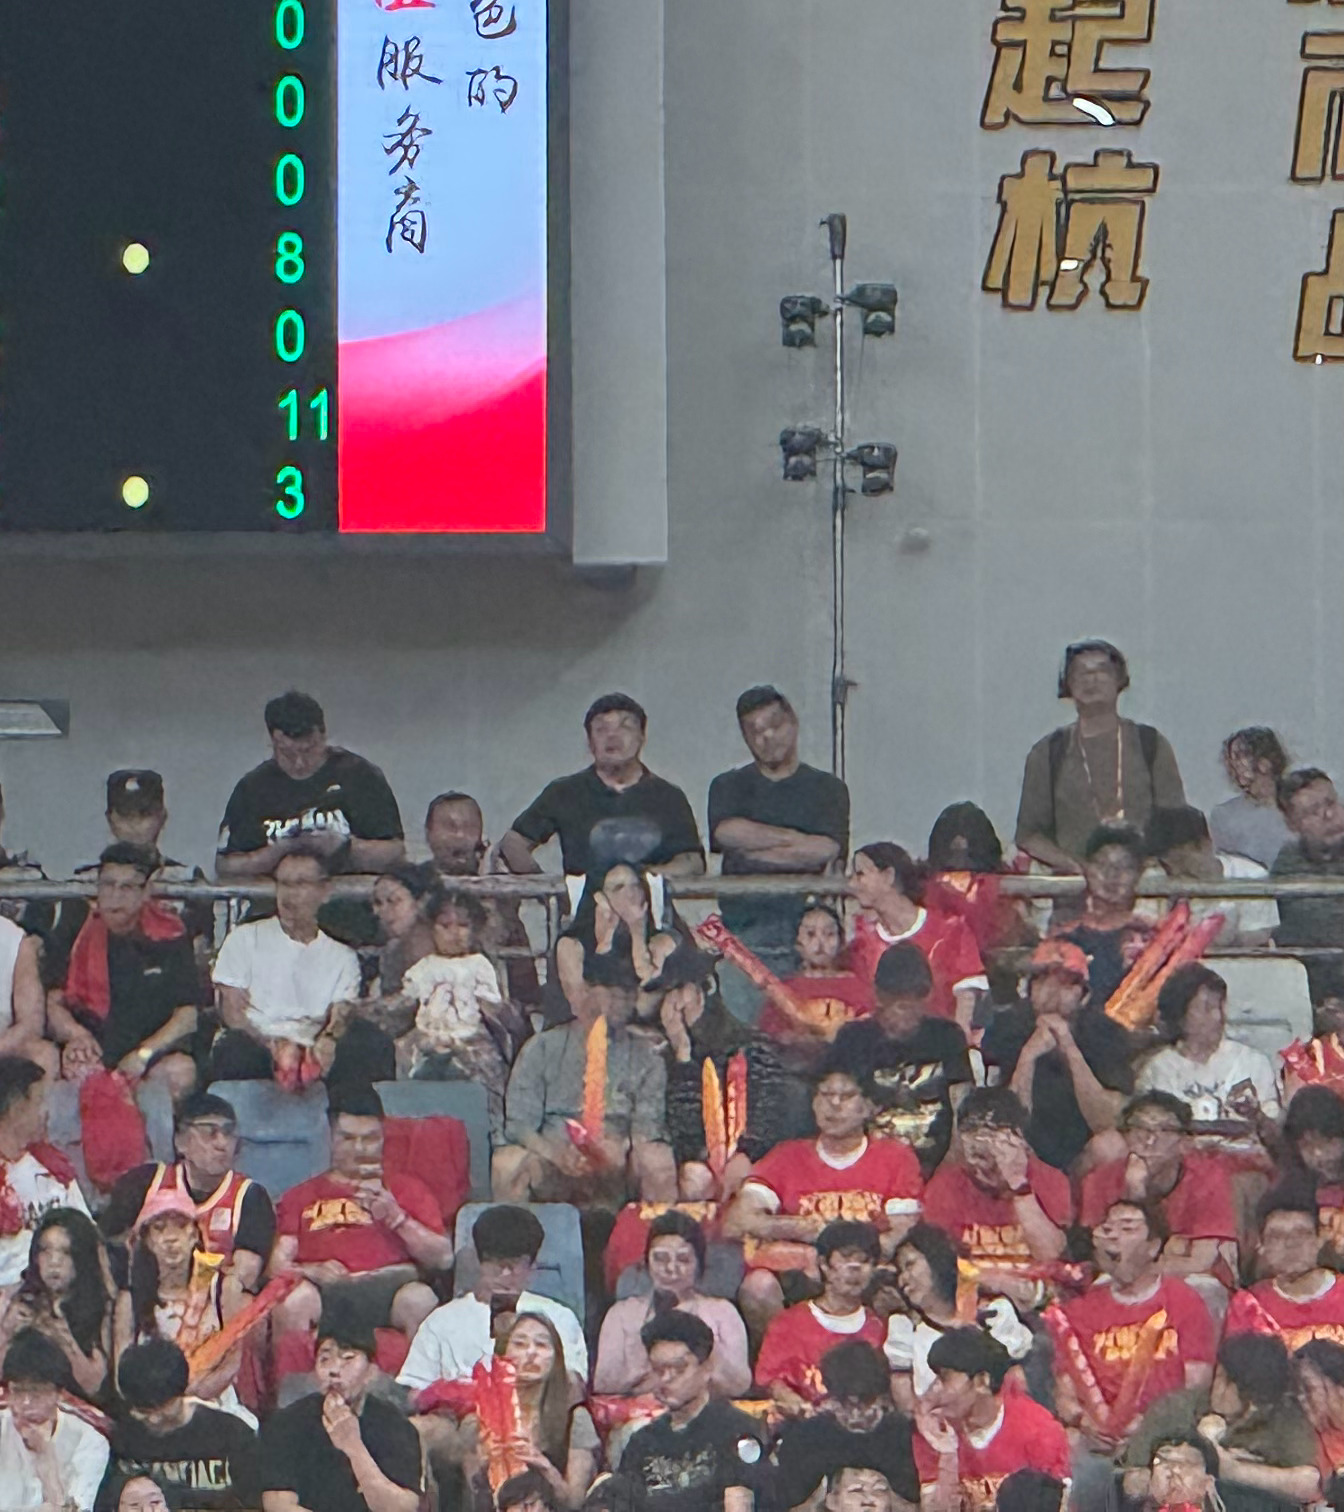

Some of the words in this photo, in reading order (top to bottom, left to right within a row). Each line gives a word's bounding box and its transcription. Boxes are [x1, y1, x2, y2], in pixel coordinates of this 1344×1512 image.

[276, 76, 304, 127] 0
[276, 154, 304, 206] 0
[276, 232, 304, 283] 8
[276, 310, 304, 362] 0
[278, 388, 330, 440] 11
[275, 466, 304, 519] 3
